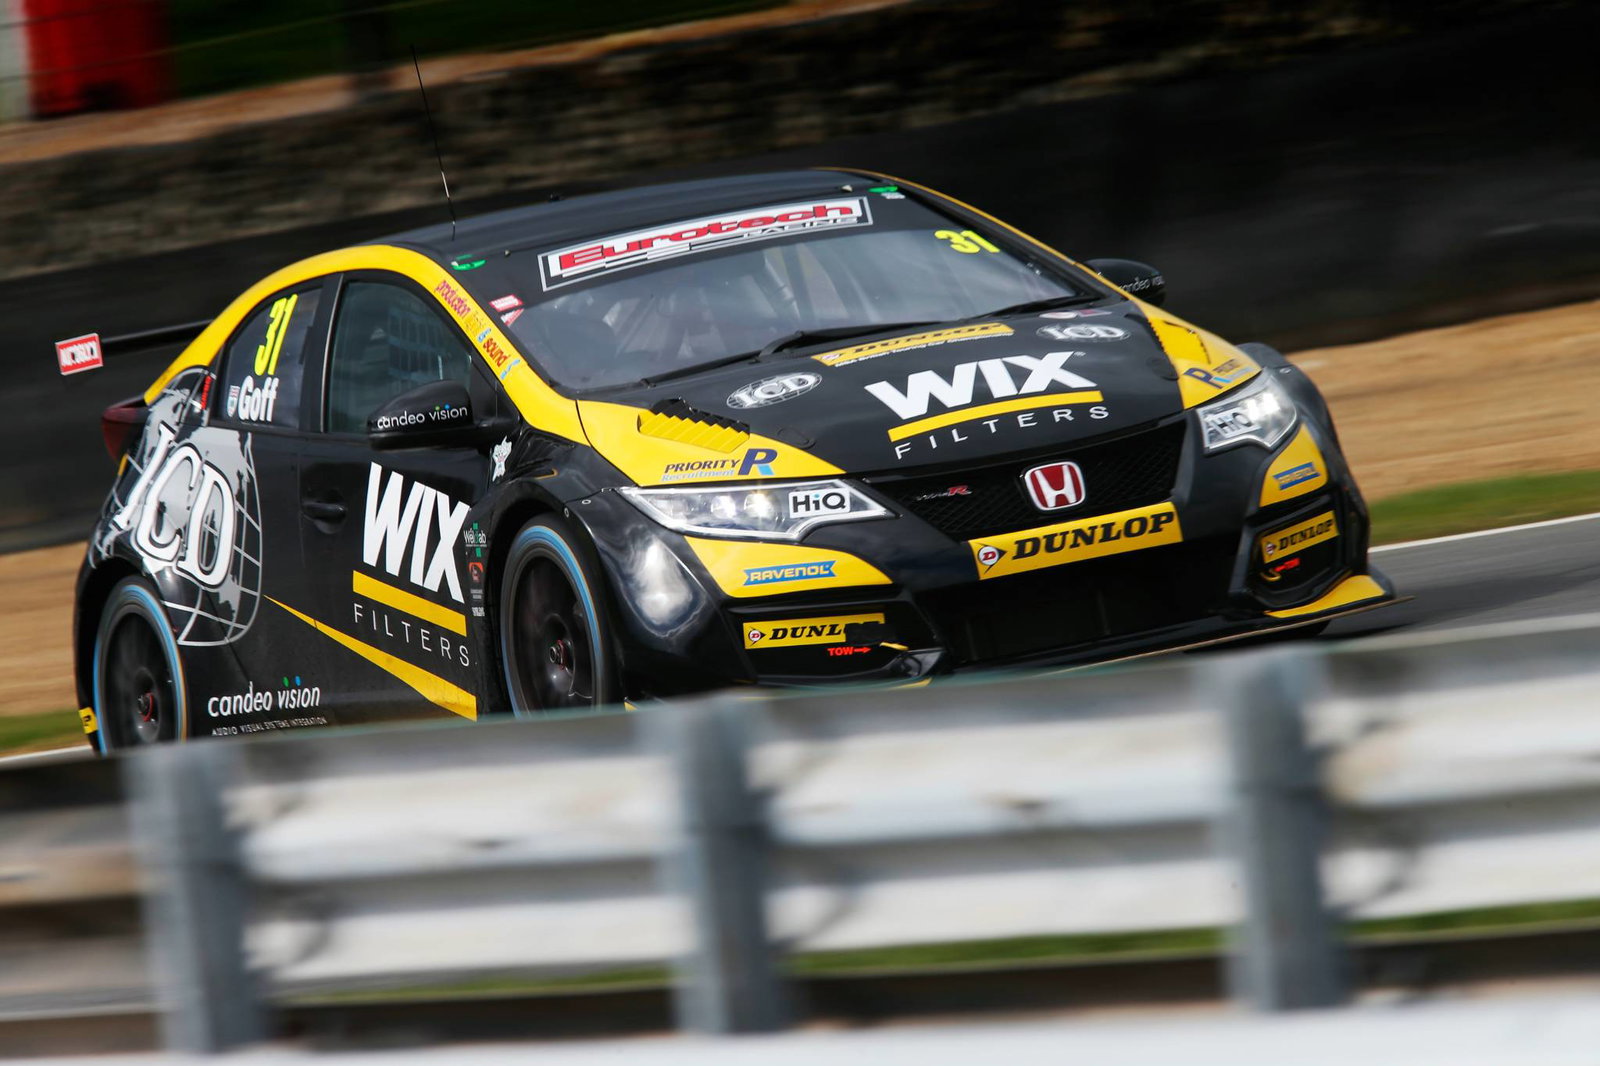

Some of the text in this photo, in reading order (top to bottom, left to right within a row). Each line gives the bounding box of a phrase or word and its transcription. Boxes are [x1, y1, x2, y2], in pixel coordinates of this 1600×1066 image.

[559, 205, 853, 271] Eurotech
[934, 230, 1000, 253] 31
[254, 294, 298, 376] 31
[434, 280, 471, 319] production
[483, 338, 511, 368] sound
[238, 375, 279, 422] Goff
[734, 374, 818, 406] ICD
[864, 351, 1097, 420] WIX
[377, 404, 468, 429] candeo vision
[894, 406, 1109, 460] FILTERS
[661, 469, 735, 482] Recruitment
[664, 458, 742, 474] PRIORITY
[113, 424, 235, 586] ICD
[792, 492, 846, 513] HiQ
[363, 461, 470, 604] WIX
[1012, 512, 1174, 561] DUNLOP
[1279, 519, 1333, 551] DUNLOP
[750, 564, 830, 582] RAVENOL
[353, 603, 470, 667] FILTERS
[769, 623, 847, 641] DUNL
[828, 646, 854, 656] TOW
[208, 675, 320, 717] candeo vision
[240, 721, 264, 733] VISUAL
